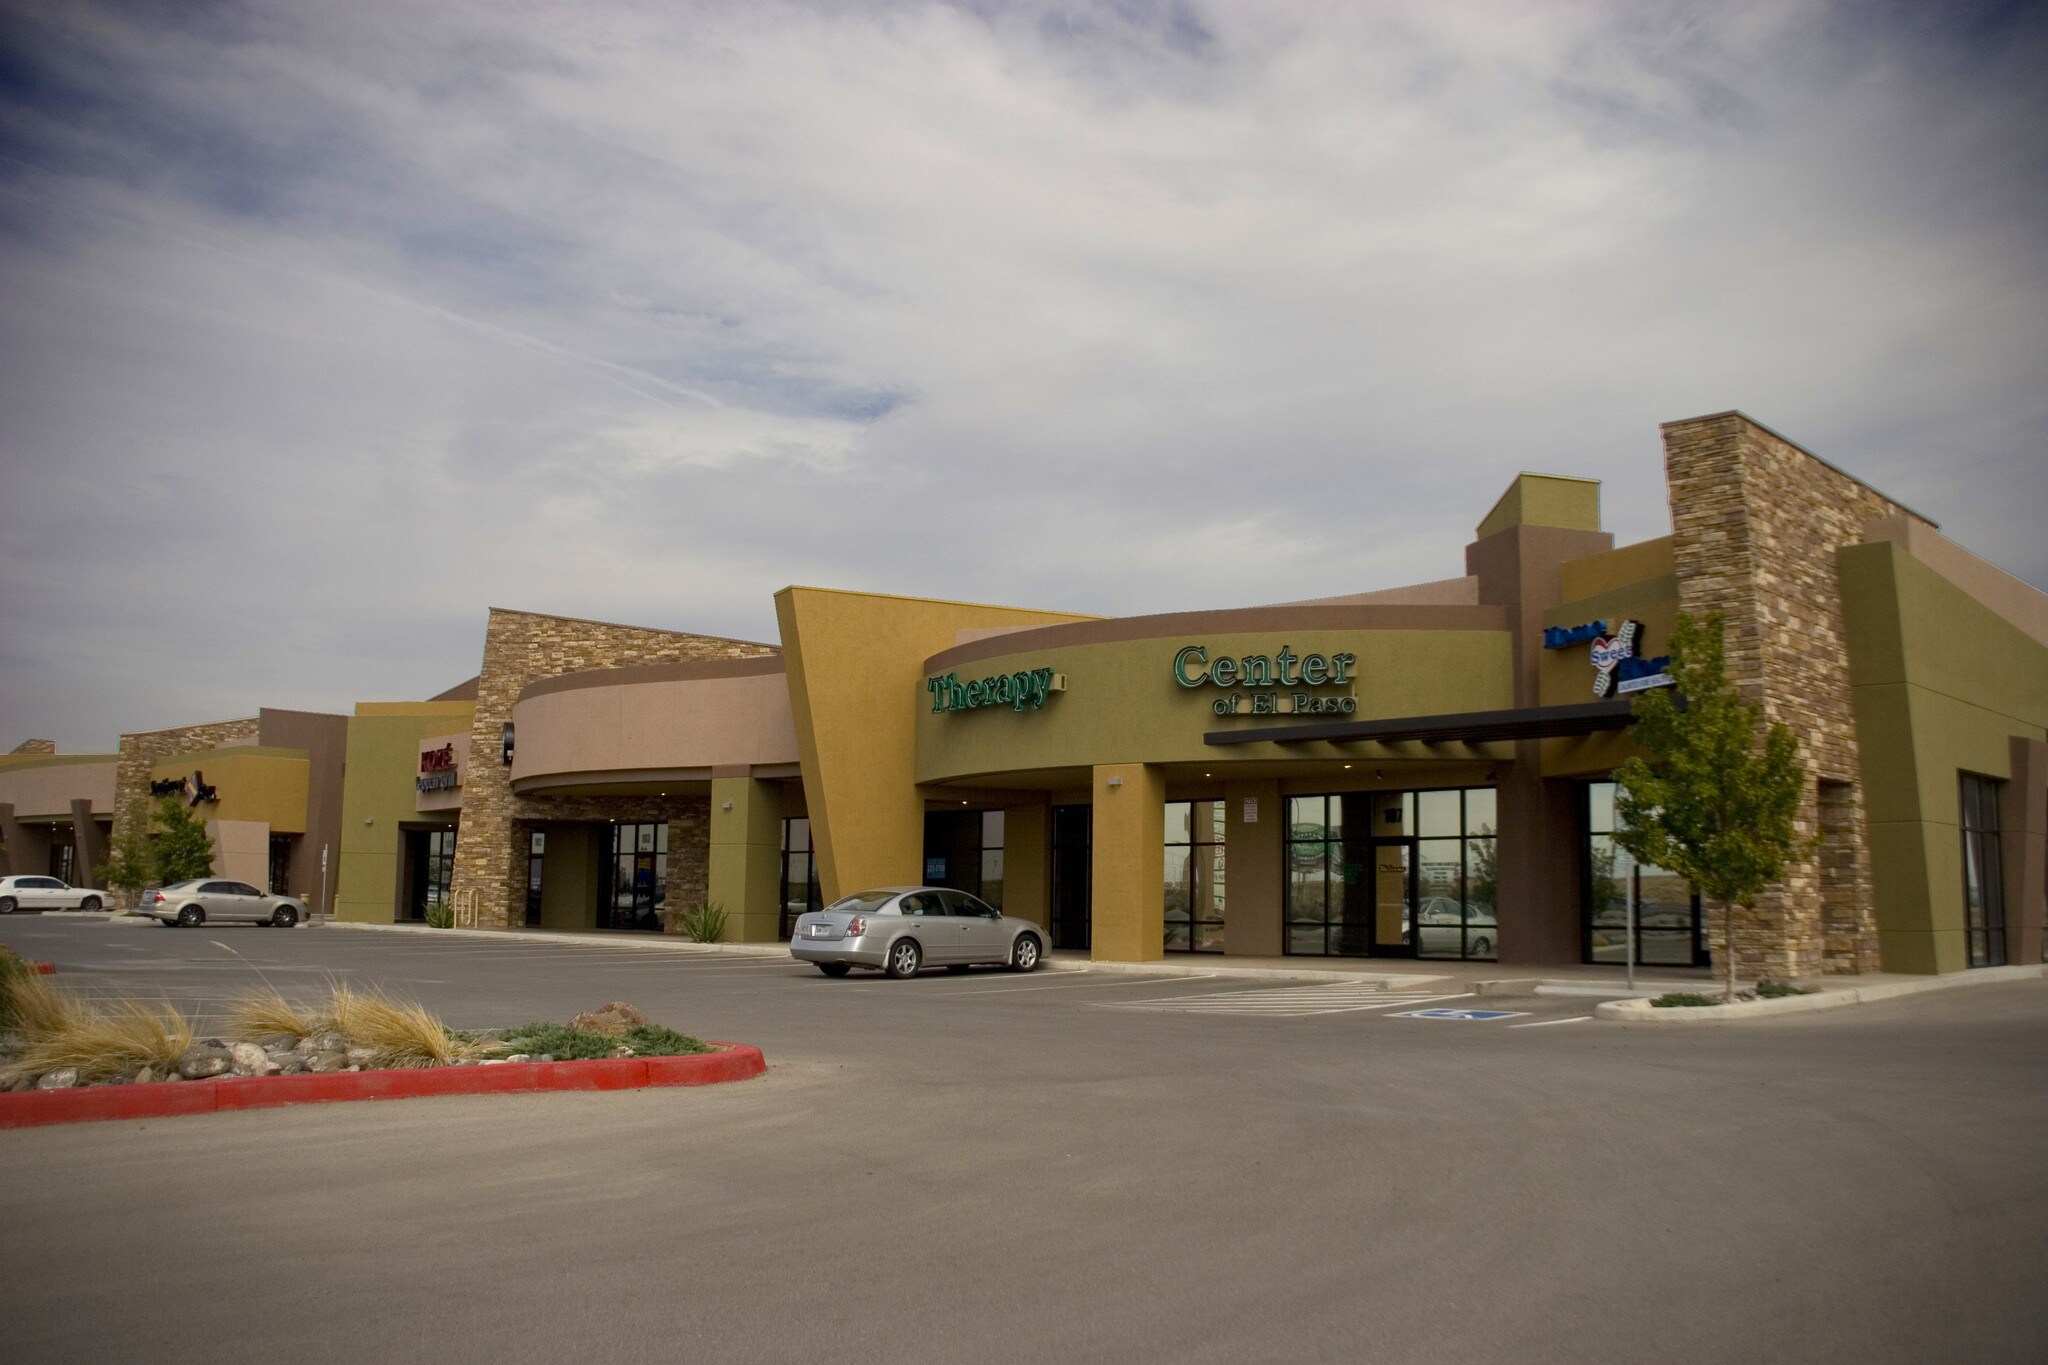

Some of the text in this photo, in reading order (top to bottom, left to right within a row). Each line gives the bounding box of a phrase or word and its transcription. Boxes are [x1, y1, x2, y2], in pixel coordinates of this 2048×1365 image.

[927, 645, 1355, 714] Therapy Center
[1212, 692, 1356, 715] of El Paso
